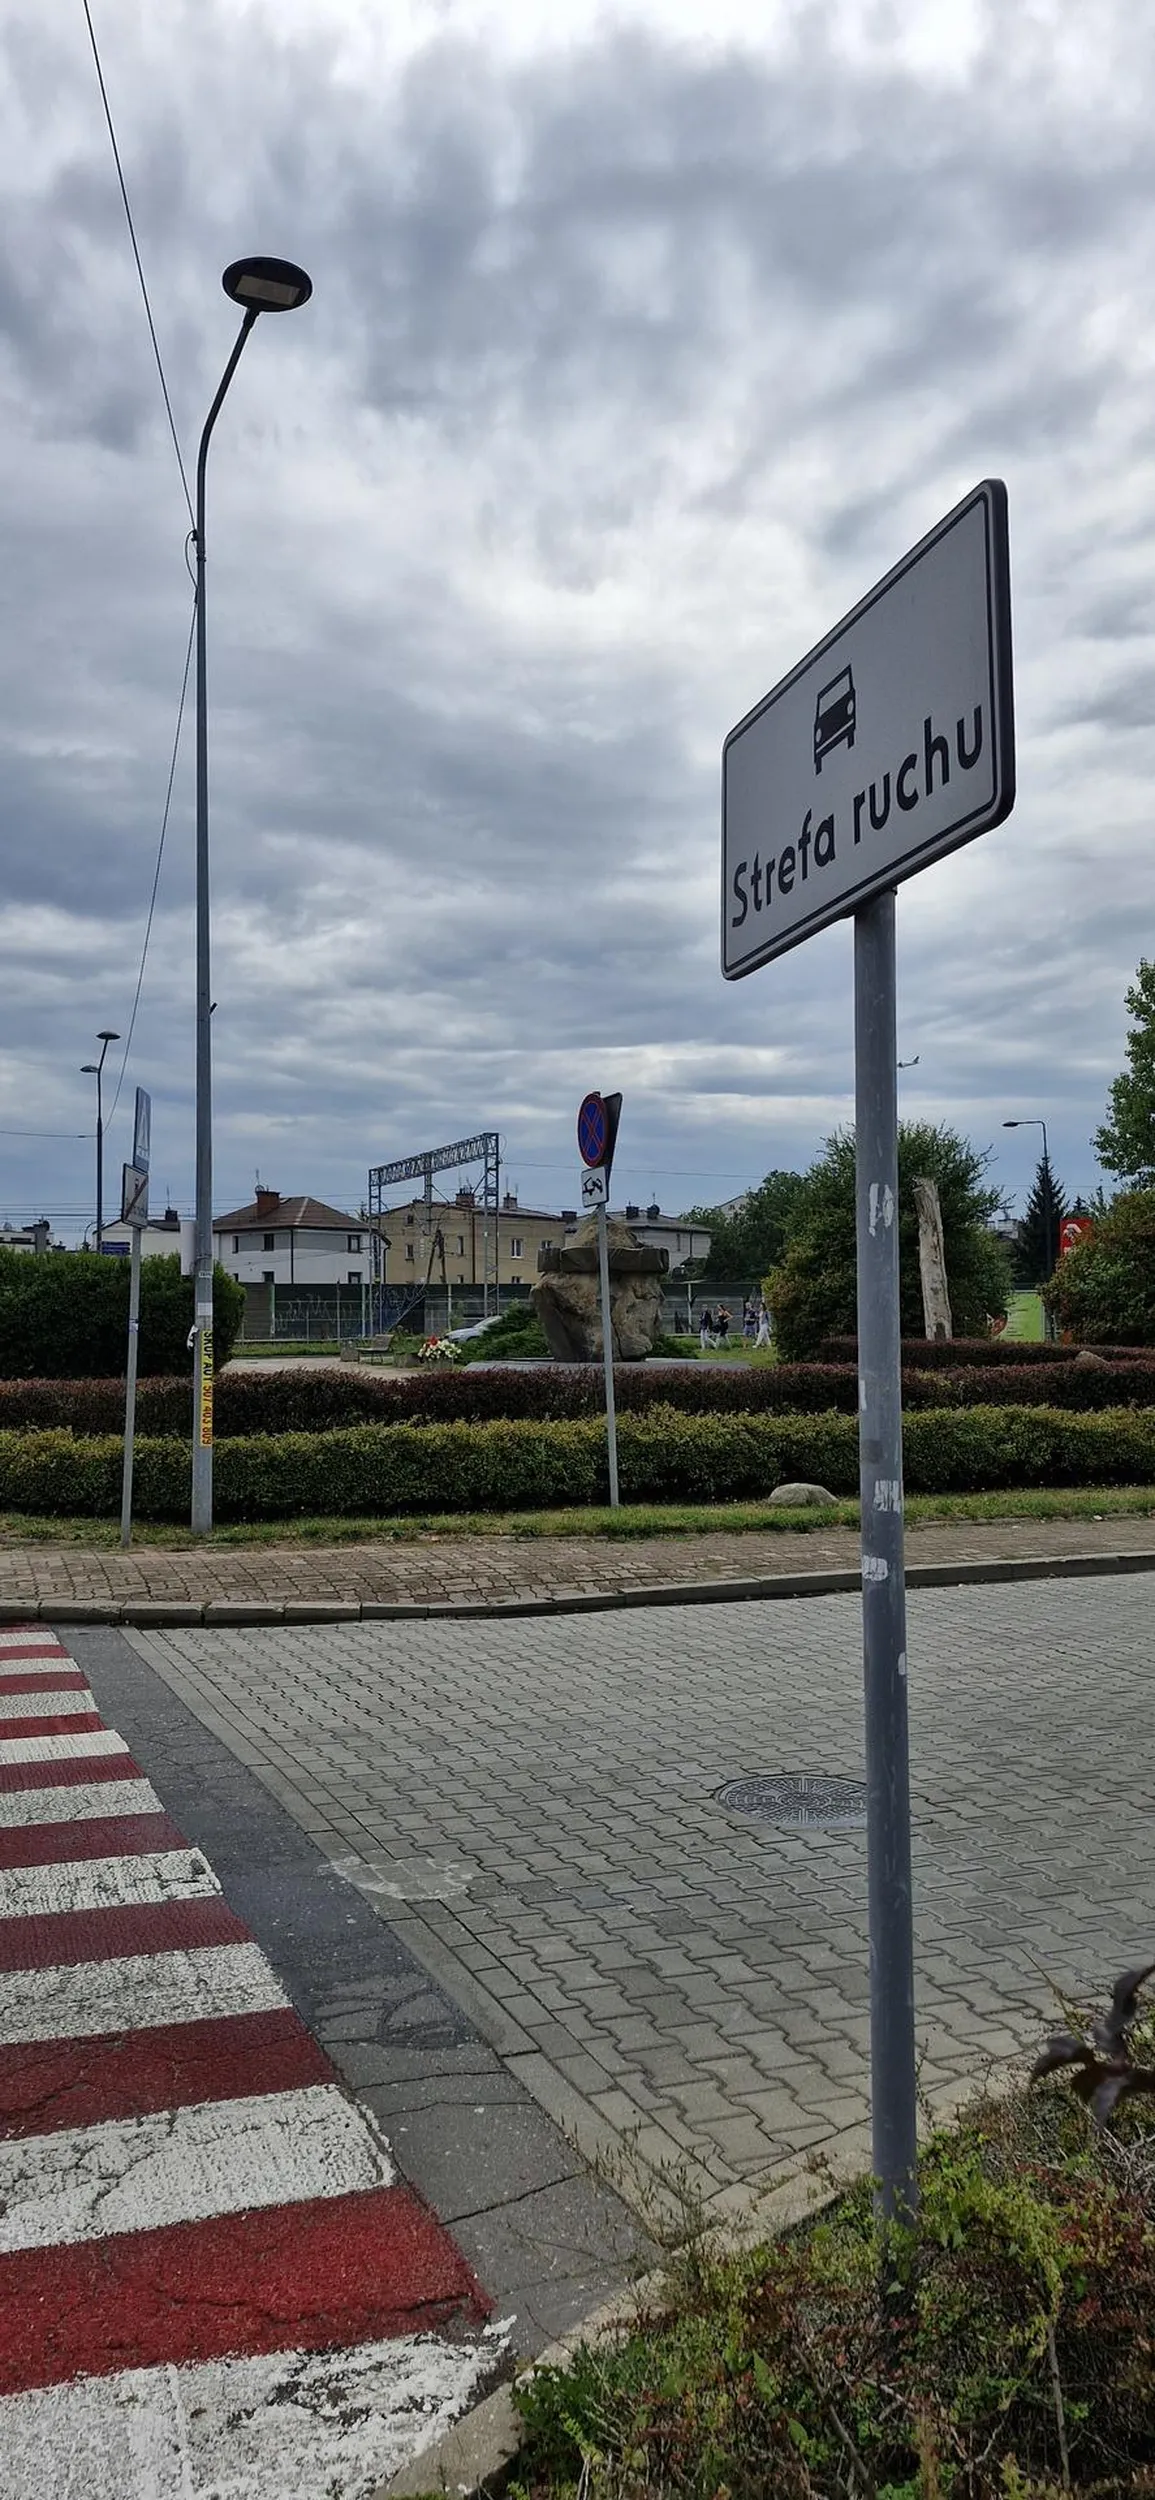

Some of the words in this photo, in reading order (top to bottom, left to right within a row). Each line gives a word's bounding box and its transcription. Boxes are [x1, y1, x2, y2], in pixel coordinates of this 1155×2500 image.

[732, 809, 835, 928] Strefa
[853, 705, 983, 845] ruchu
[203, 1331, 213, 1359] SKUP
